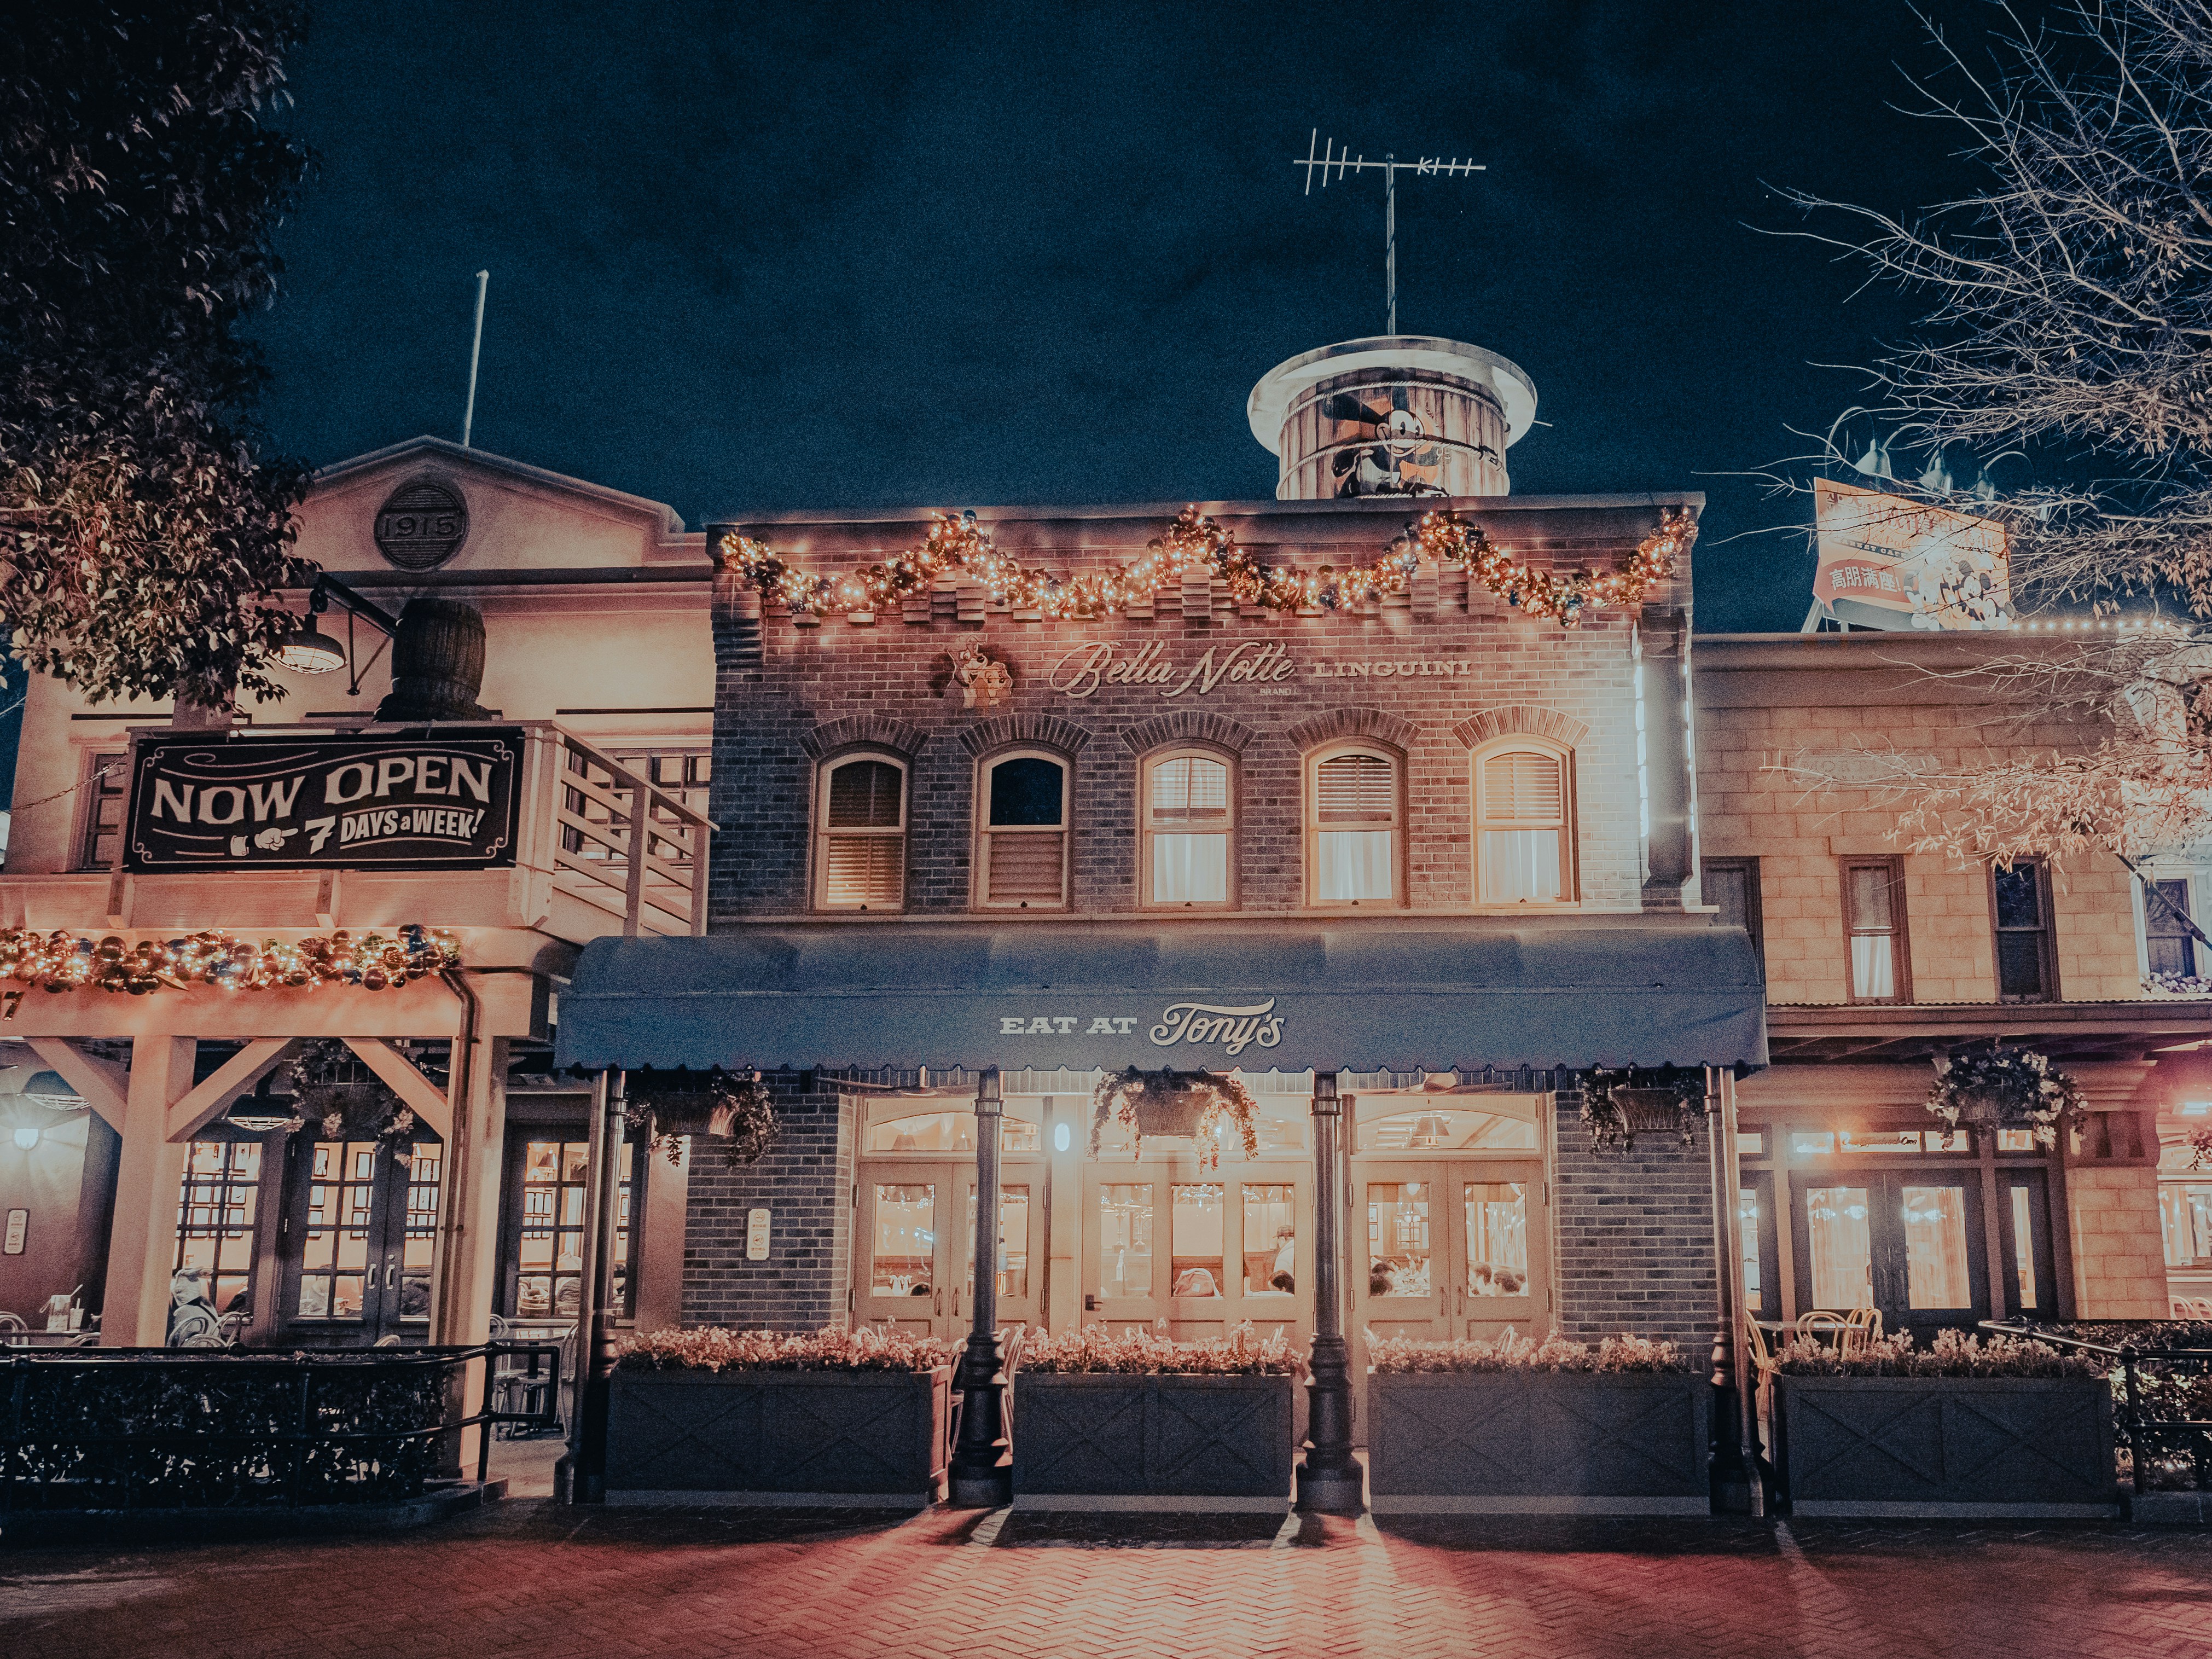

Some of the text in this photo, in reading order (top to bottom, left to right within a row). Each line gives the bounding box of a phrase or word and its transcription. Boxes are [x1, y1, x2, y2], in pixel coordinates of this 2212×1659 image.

[382, 515, 455, 536] 1915
[1829, 566, 1901, 593] 高朋满座!
[1049, 640, 1295, 698] Bella Notte
[1313, 660, 1472, 677] LINGUINI
[1259, 688, 1292, 696] BRAND
[150, 756, 492, 824] NOW OPEN
[305, 815, 336, 855] 7
[340, 810, 399, 843] DAYS
[413, 808, 486, 839] WEEK!
[1000, 996, 1285, 1056] EAT AT Tony's
